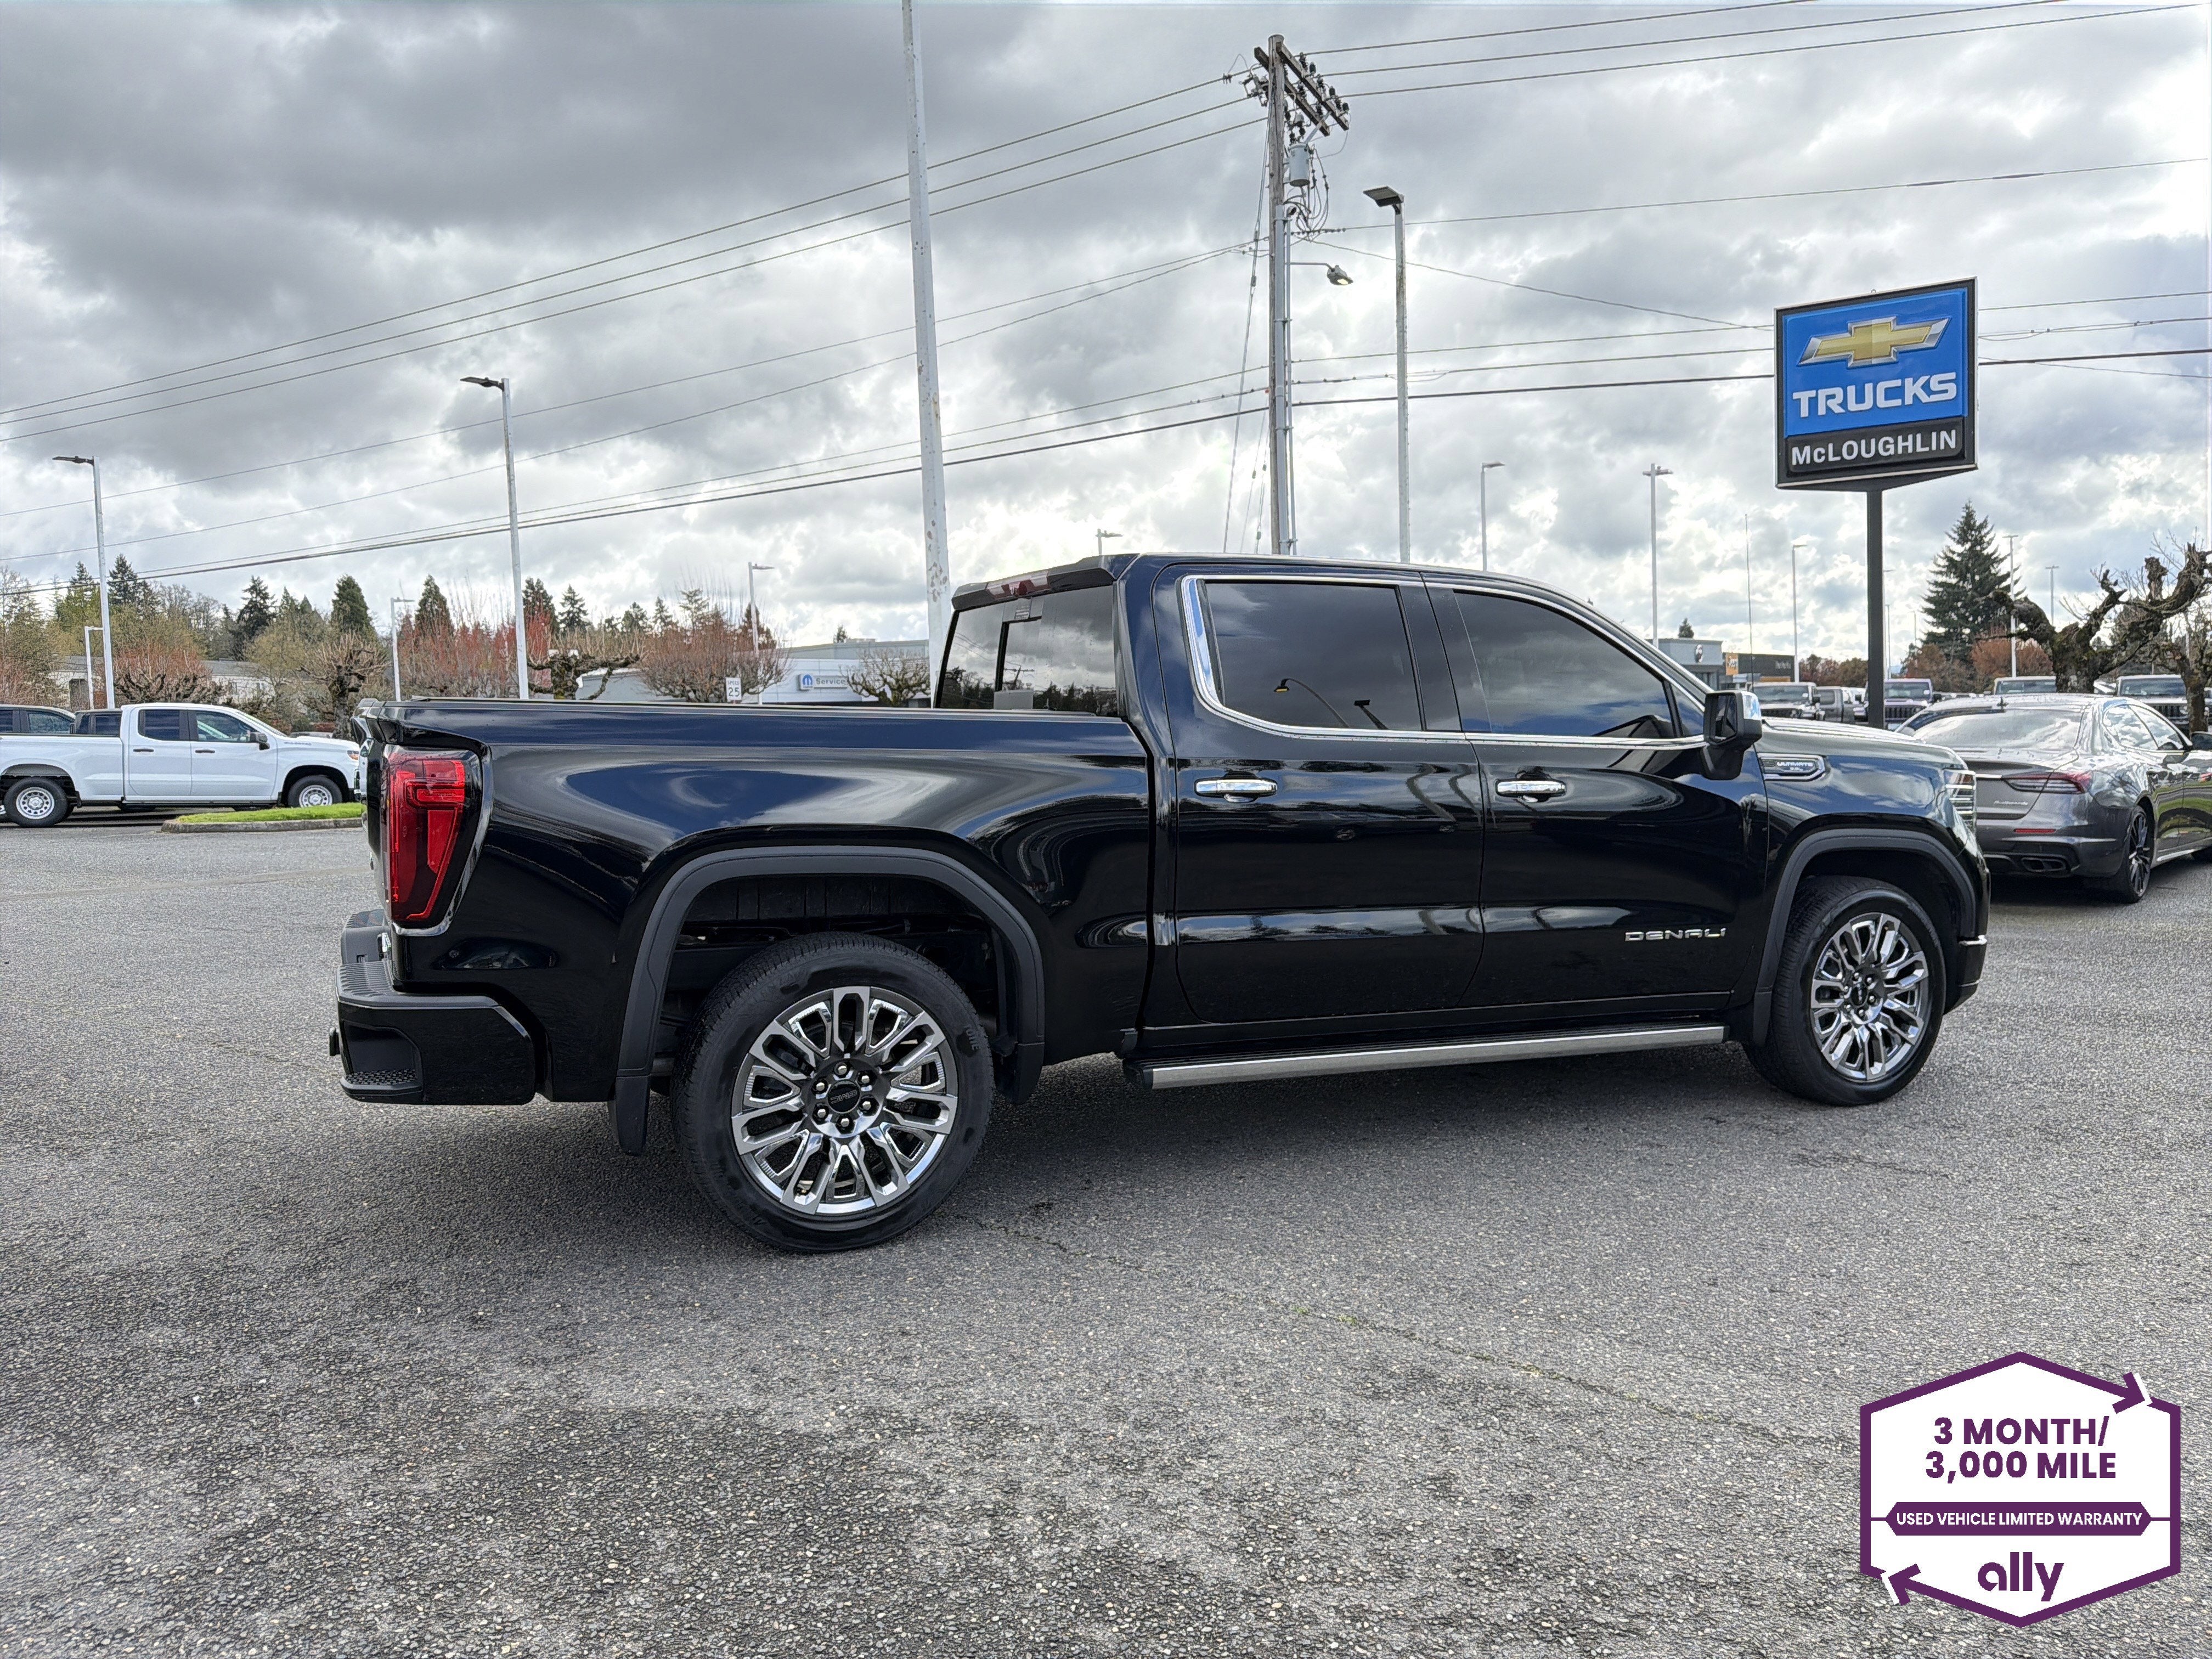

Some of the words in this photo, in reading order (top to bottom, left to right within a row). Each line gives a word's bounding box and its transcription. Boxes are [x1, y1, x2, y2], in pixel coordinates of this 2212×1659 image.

[1792, 372, 1956, 417] TRUCKS
[1792, 430, 1956, 466] McLOUGHLIN
[728, 686, 740, 697] 25
[1624, 928, 1726, 942] DENALI
